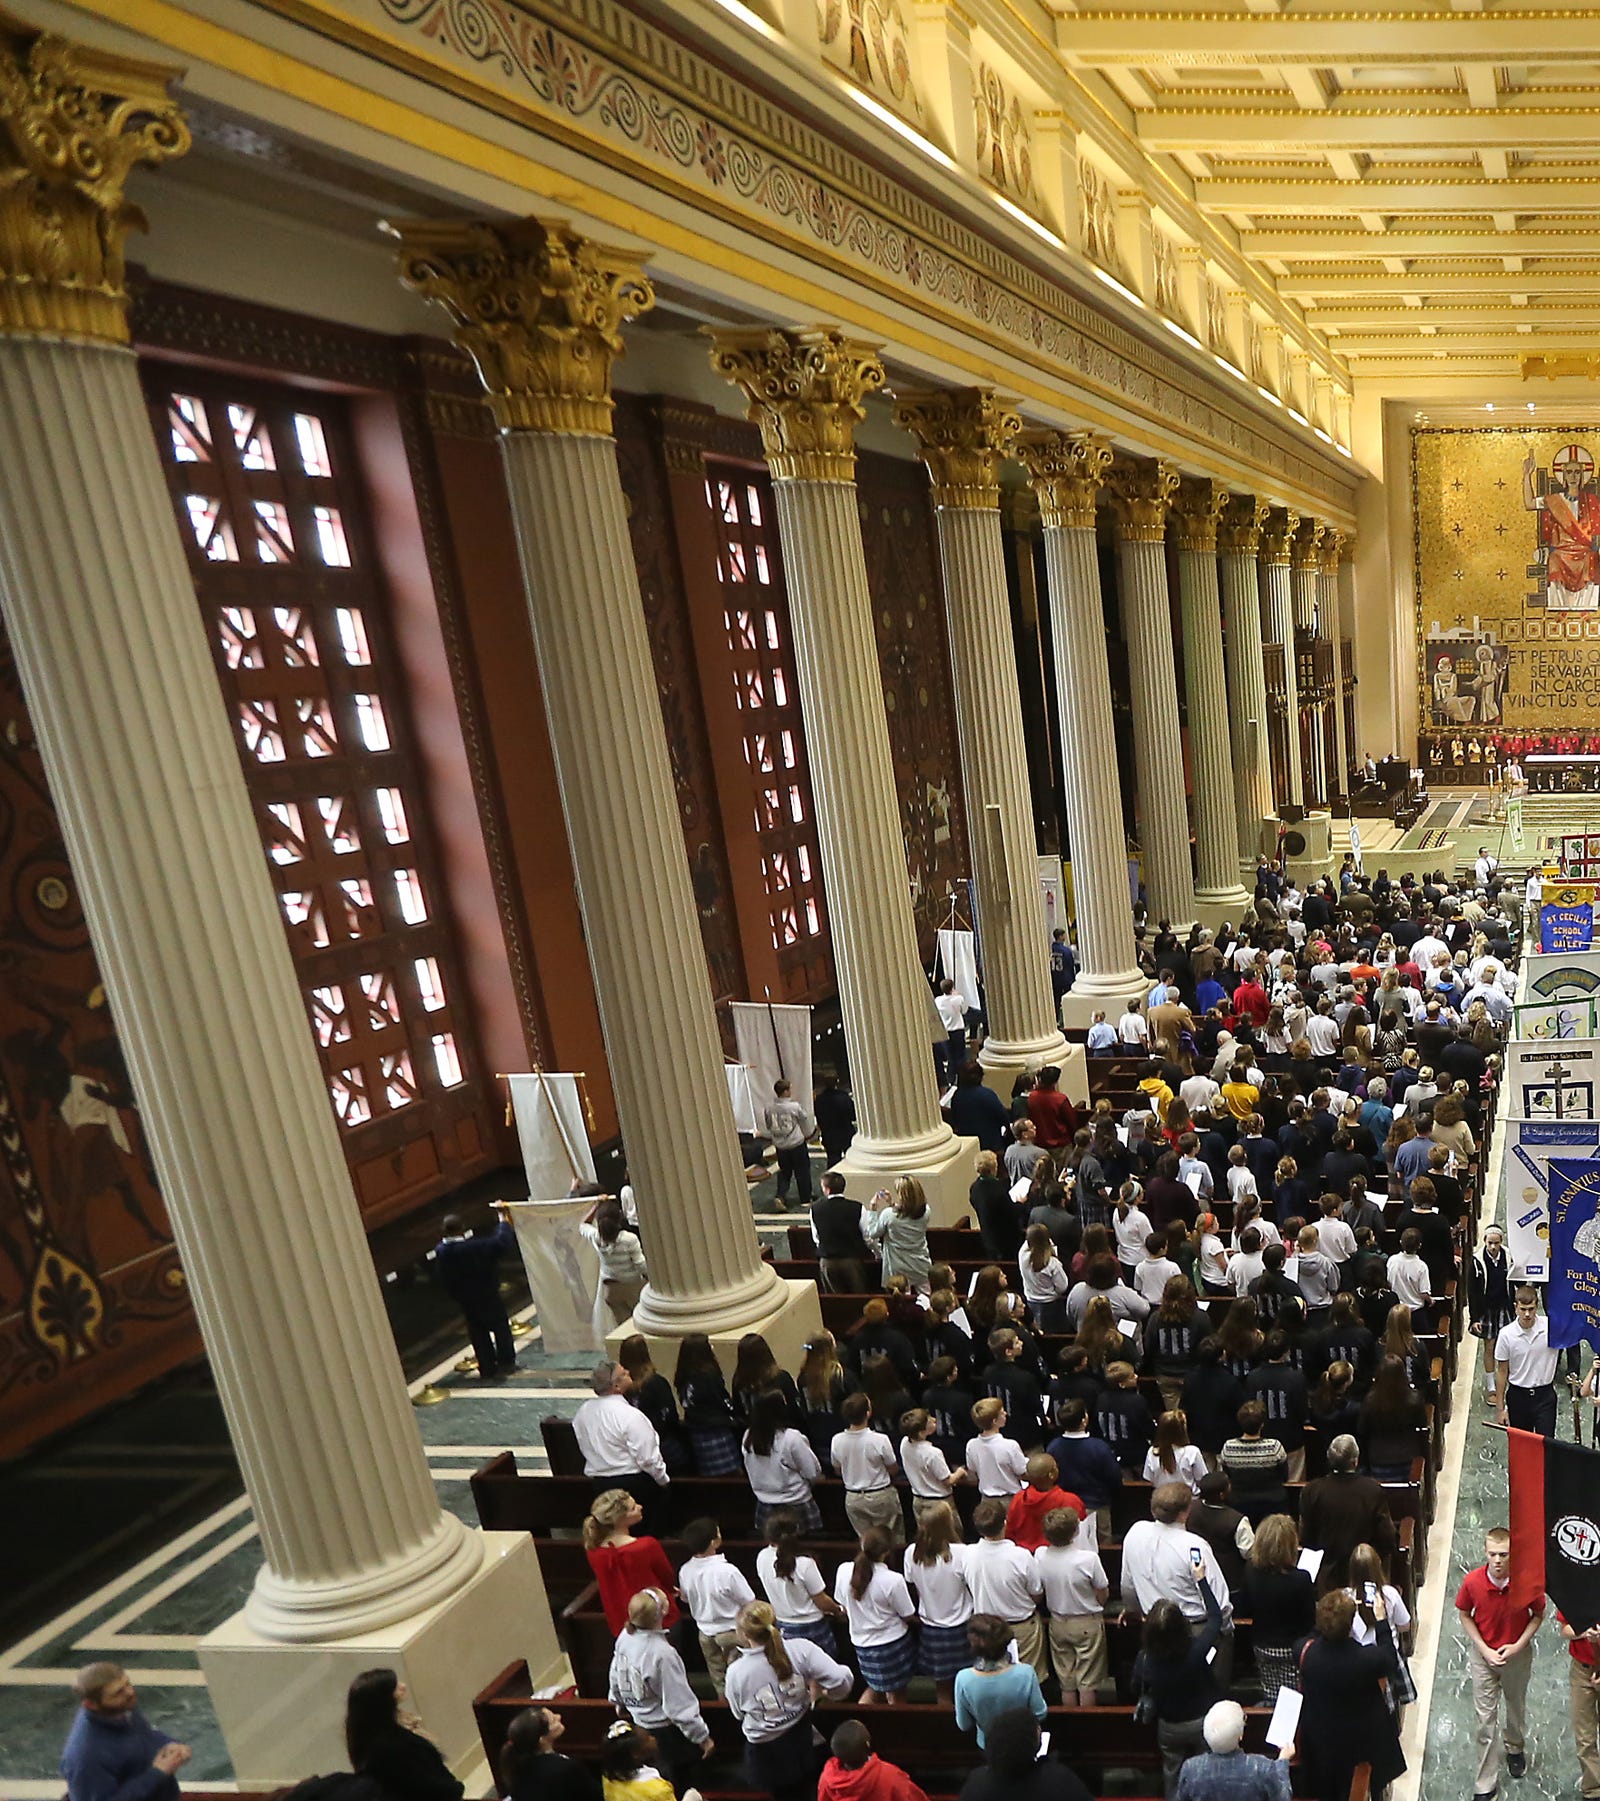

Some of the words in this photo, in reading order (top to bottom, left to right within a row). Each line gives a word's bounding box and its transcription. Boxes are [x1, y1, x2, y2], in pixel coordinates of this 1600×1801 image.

[1509, 650, 1527, 664] ET
[1531, 649, 1583, 664] PETRUS
[1530, 679, 1547, 693] IN
[1507, 694, 1577, 708] VINCTUS
[1546, 914, 1556, 925] ST
[1559, 913, 1588, 925] CECILIA
[1552, 927, 1582, 935] SCHOOL
[1557, 1171, 1600, 1207] IGNATIUS
[1566, 1269, 1583, 1280] For
[1586, 1271, 1599, 1284] the
[1574, 1281, 1597, 1297] Glory
